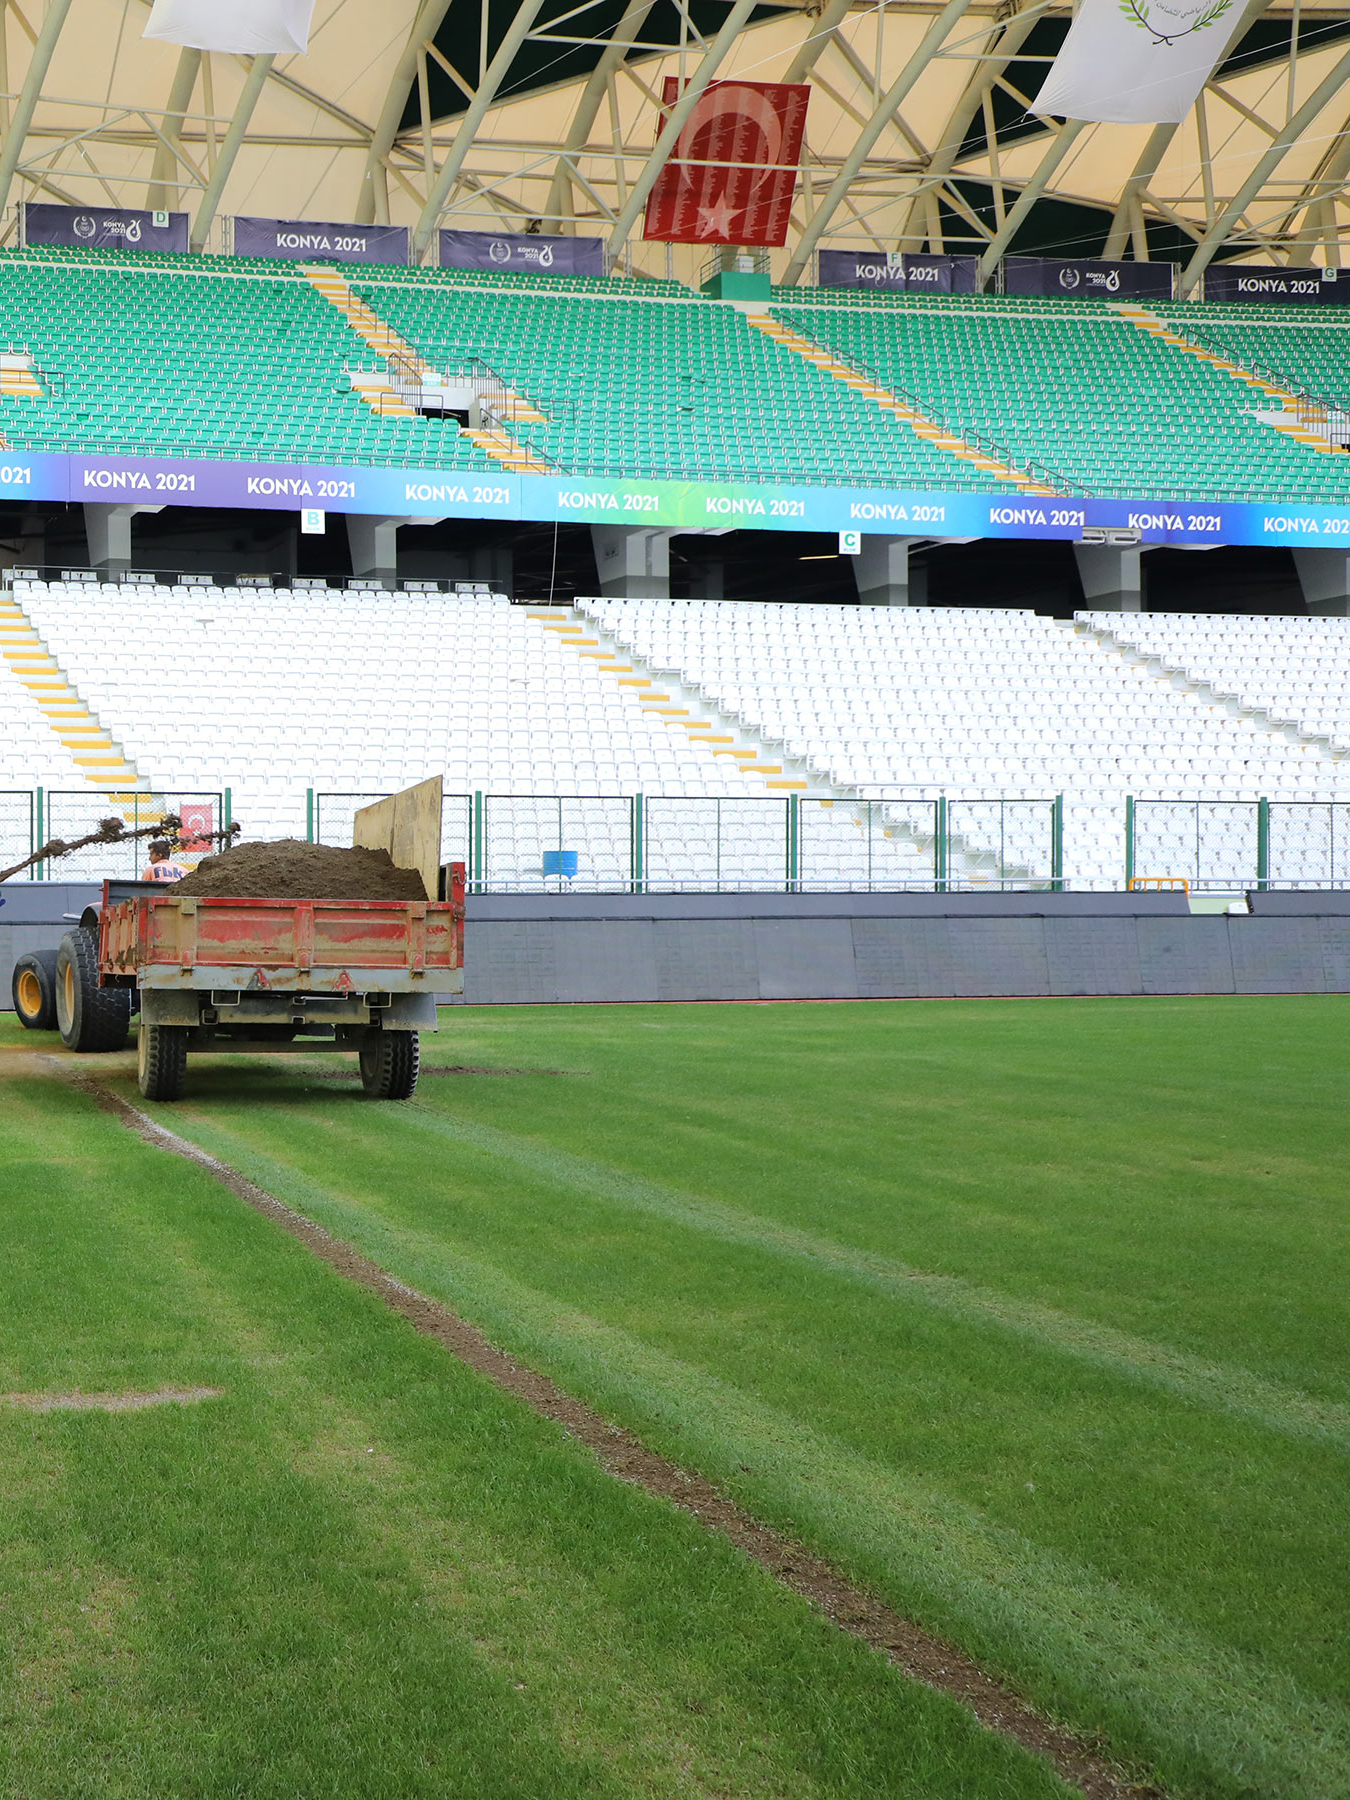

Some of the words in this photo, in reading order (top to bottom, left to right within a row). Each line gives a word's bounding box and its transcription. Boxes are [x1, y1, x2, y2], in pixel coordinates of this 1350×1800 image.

[157, 212, 166, 223] D
[277, 234, 331, 249] KONYA
[335, 237, 365, 251] 2021
[891, 253, 898, 263] F
[856, 264, 906, 280] KONYA
[909, 268, 938, 281] 2021
[1325, 267, 1334, 278] G
[1239, 279, 1287, 292] KONYA
[1291, 281, 1319, 293] 2021
[85, 470, 151, 489] KONYA
[156, 473, 194, 490] 2021
[248, 478, 313, 496] KONYA
[317, 480, 354, 497] 2021
[406, 484, 468, 502] KONYA
[473, 487, 509, 503] 2021
[559, 492, 619, 509] KONYA
[624, 494, 658, 510] 2021
[706, 497, 765, 514] KONYA
[770, 500, 804, 516] 2021
[851, 504, 908, 520] KONYA
[912, 506, 944, 521] 2021
[307, 511, 319, 525] B
[990, 508, 1046, 524] KONYA
[1051, 511, 1084, 525] 2021
[1129, 514, 1185, 531] KONYA
[1188, 516, 1220, 530] 2021
[1265, 518, 1319, 532] KONYA
[1323, 519, 1350, 533] 202
[844, 533, 855, 546] C
